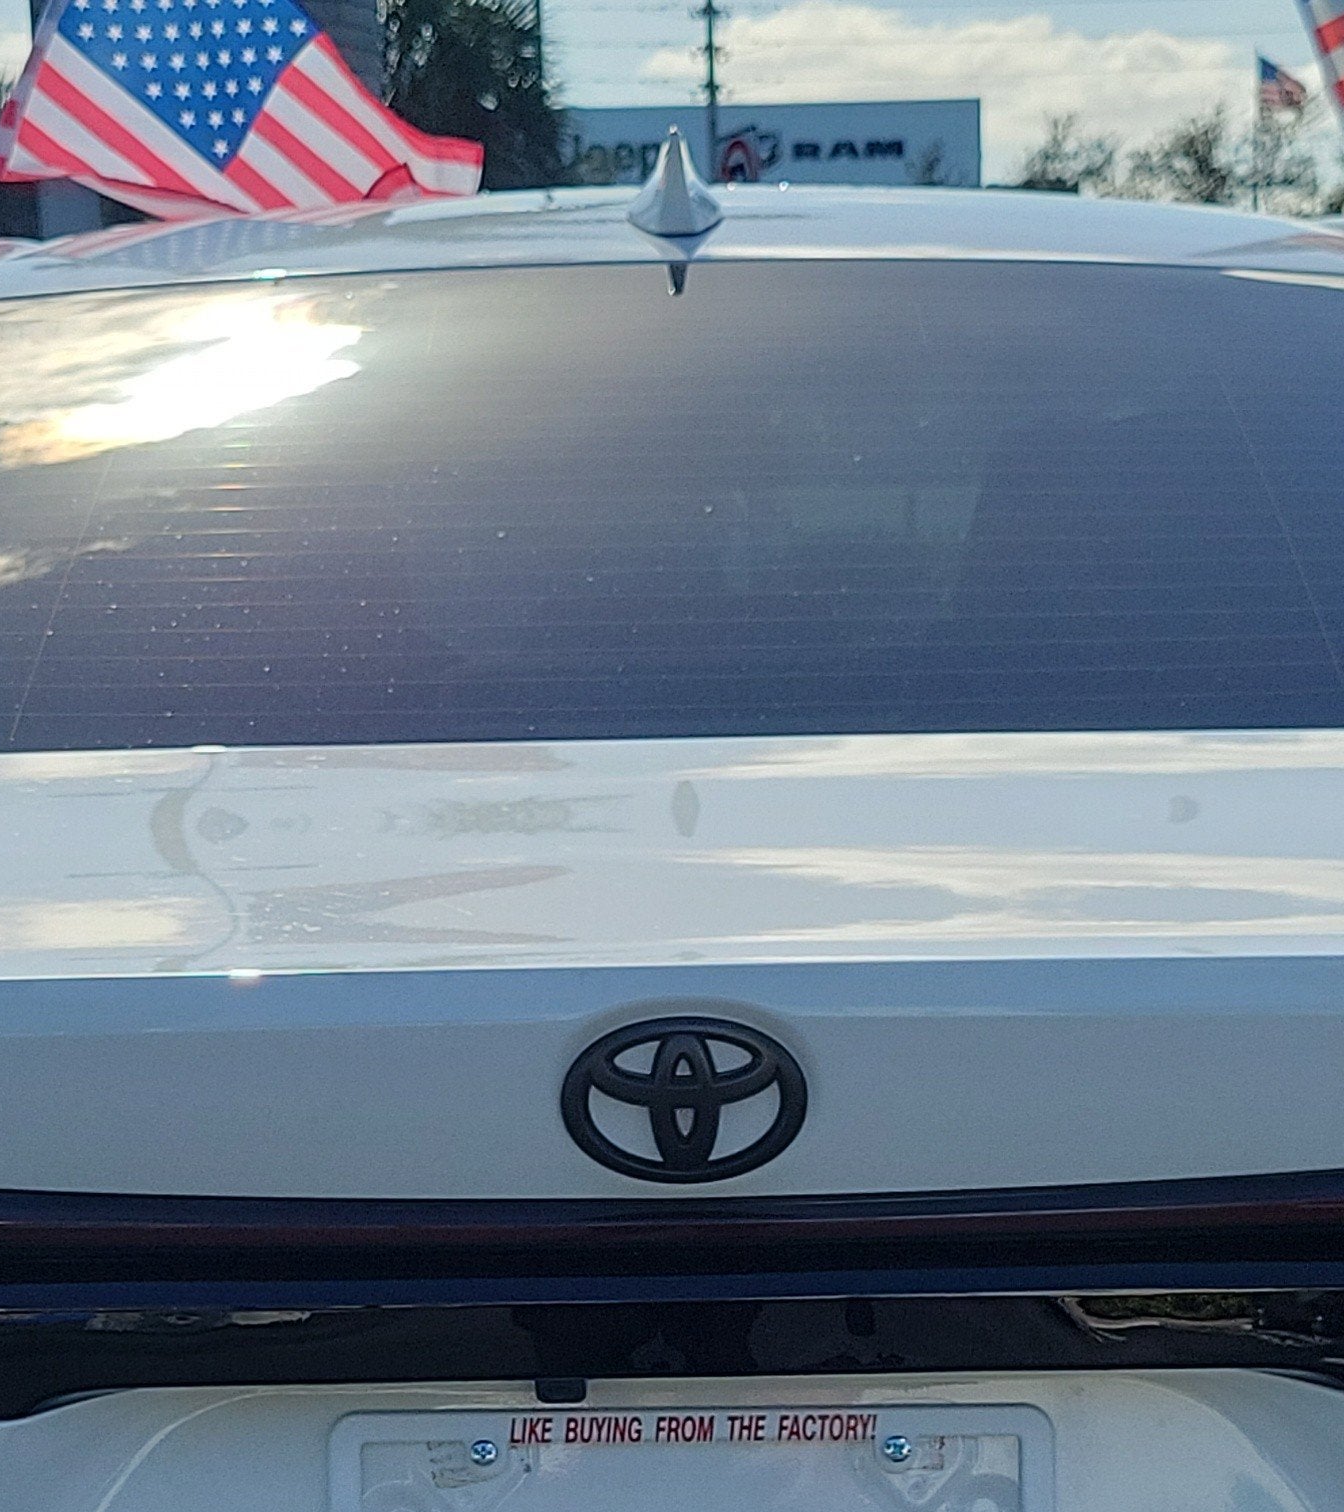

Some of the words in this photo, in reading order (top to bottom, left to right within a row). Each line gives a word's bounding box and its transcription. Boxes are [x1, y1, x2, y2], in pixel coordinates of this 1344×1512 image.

[792, 139, 904, 162] RAM
[510, 1417, 553, 1443] LIKE
[565, 1416, 642, 1443] BUYING
[655, 1415, 714, 1443] FROM
[727, 1414, 766, 1441] THE
[778, 1414, 877, 1441] FACTORY!
